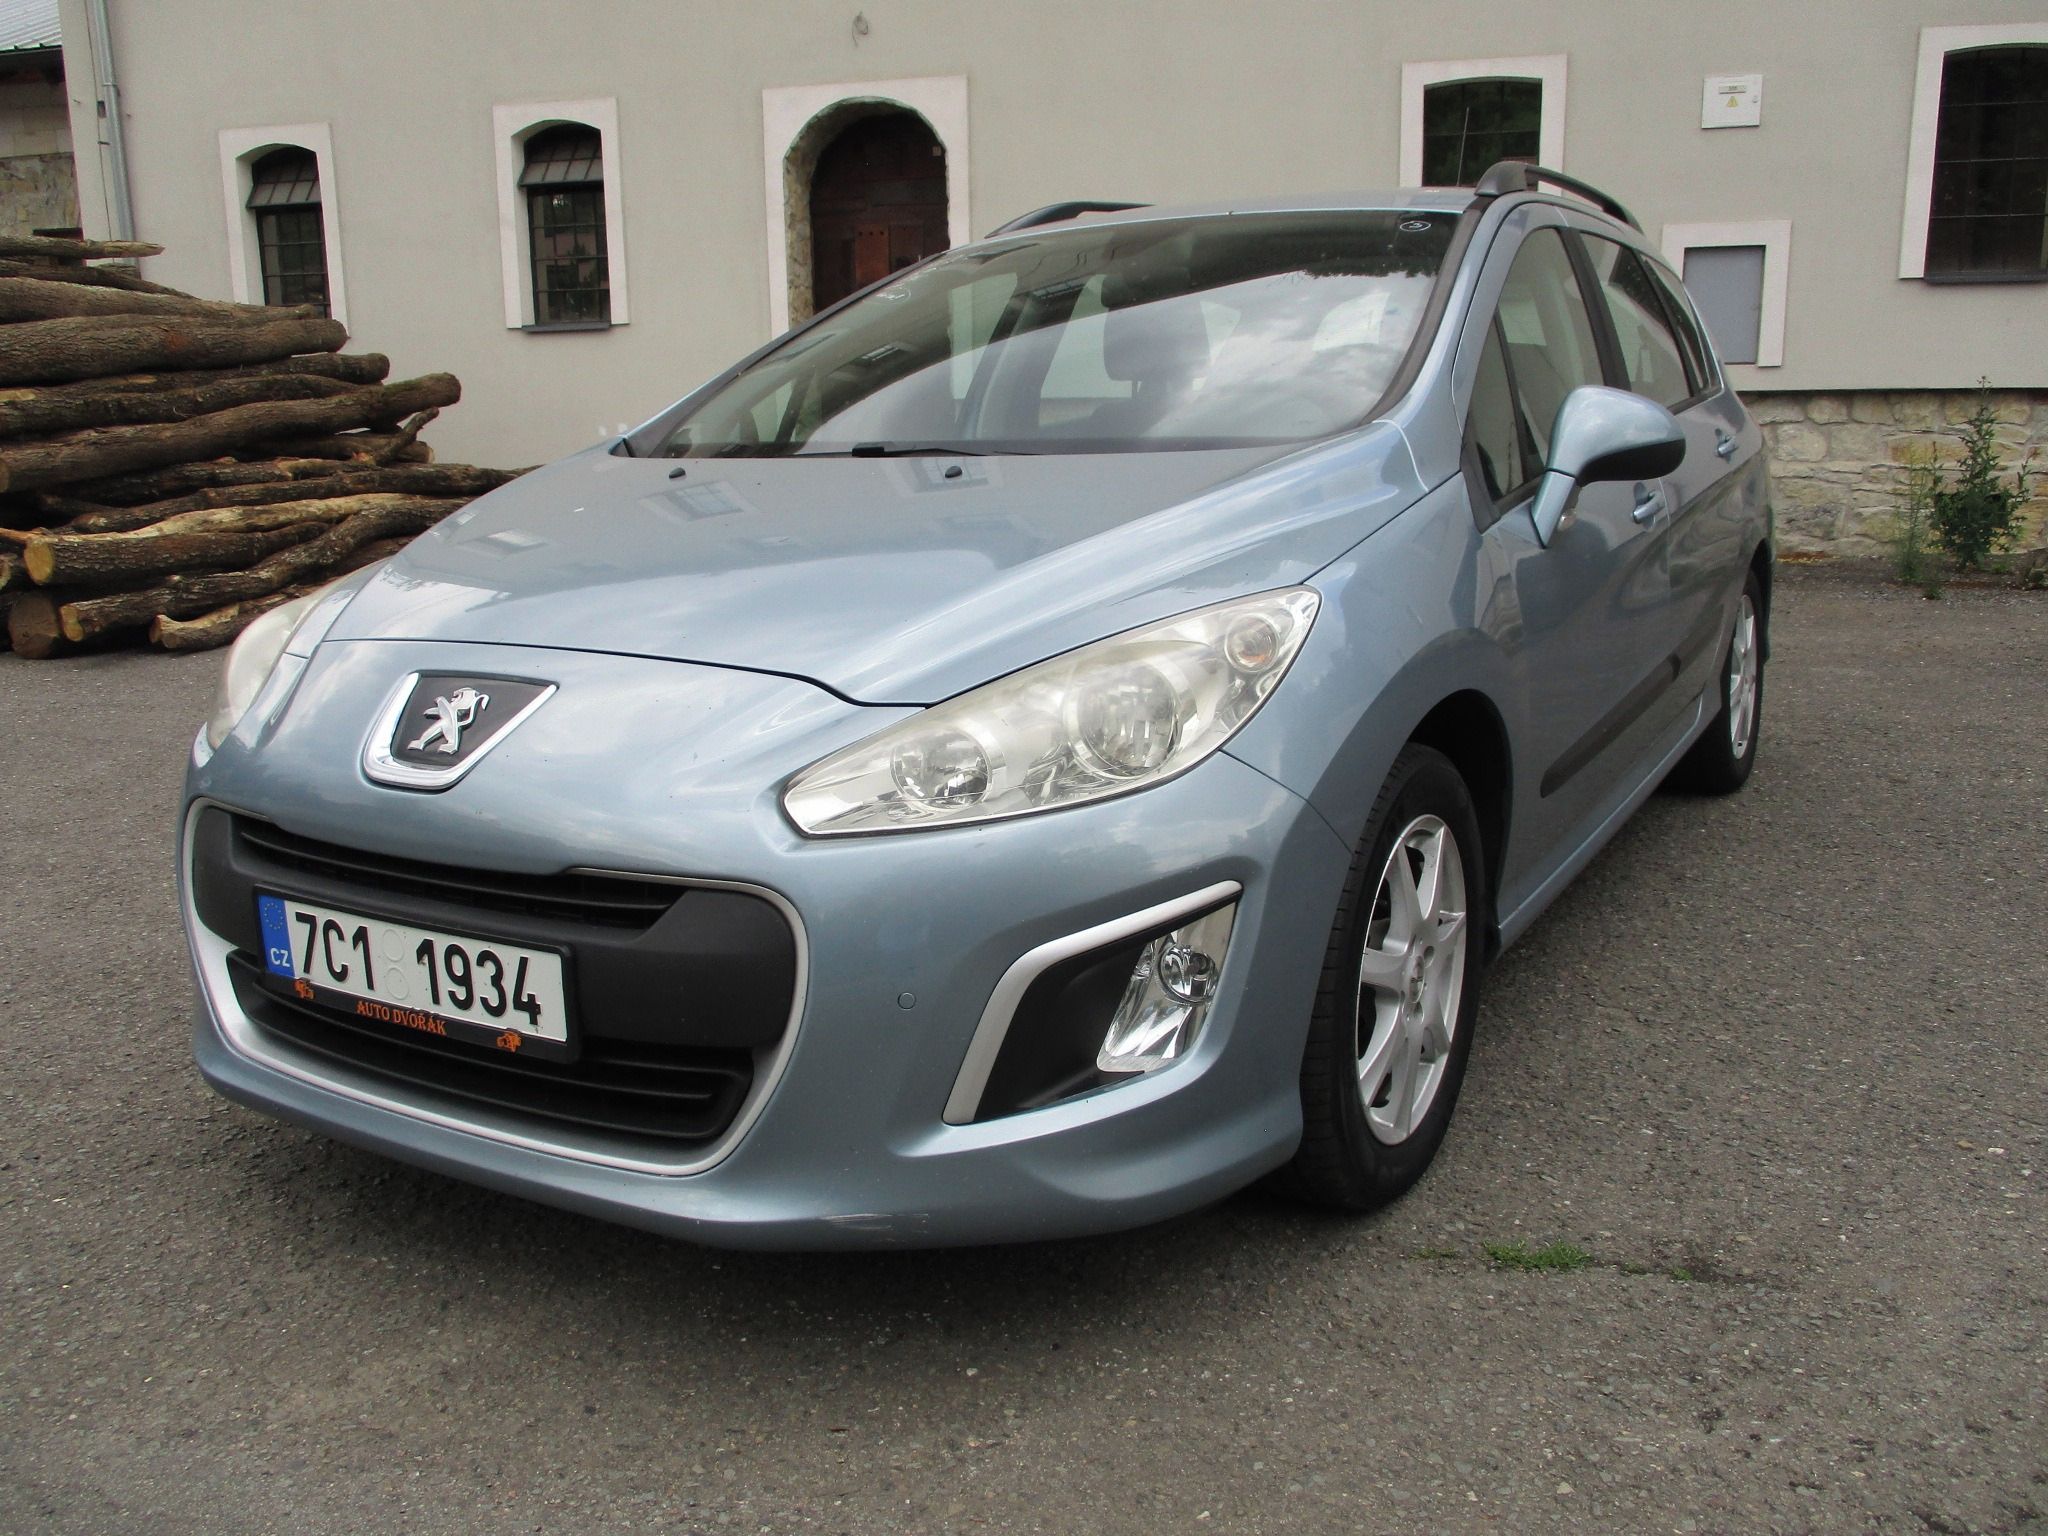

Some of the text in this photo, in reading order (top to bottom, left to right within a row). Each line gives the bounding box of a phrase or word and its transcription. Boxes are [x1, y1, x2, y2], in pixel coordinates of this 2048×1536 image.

[270, 947, 291, 968] CZ
[295, 911, 542, 1026] 7C1 1934
[356, 1001, 447, 1036] AUTO DVOŘÁK
